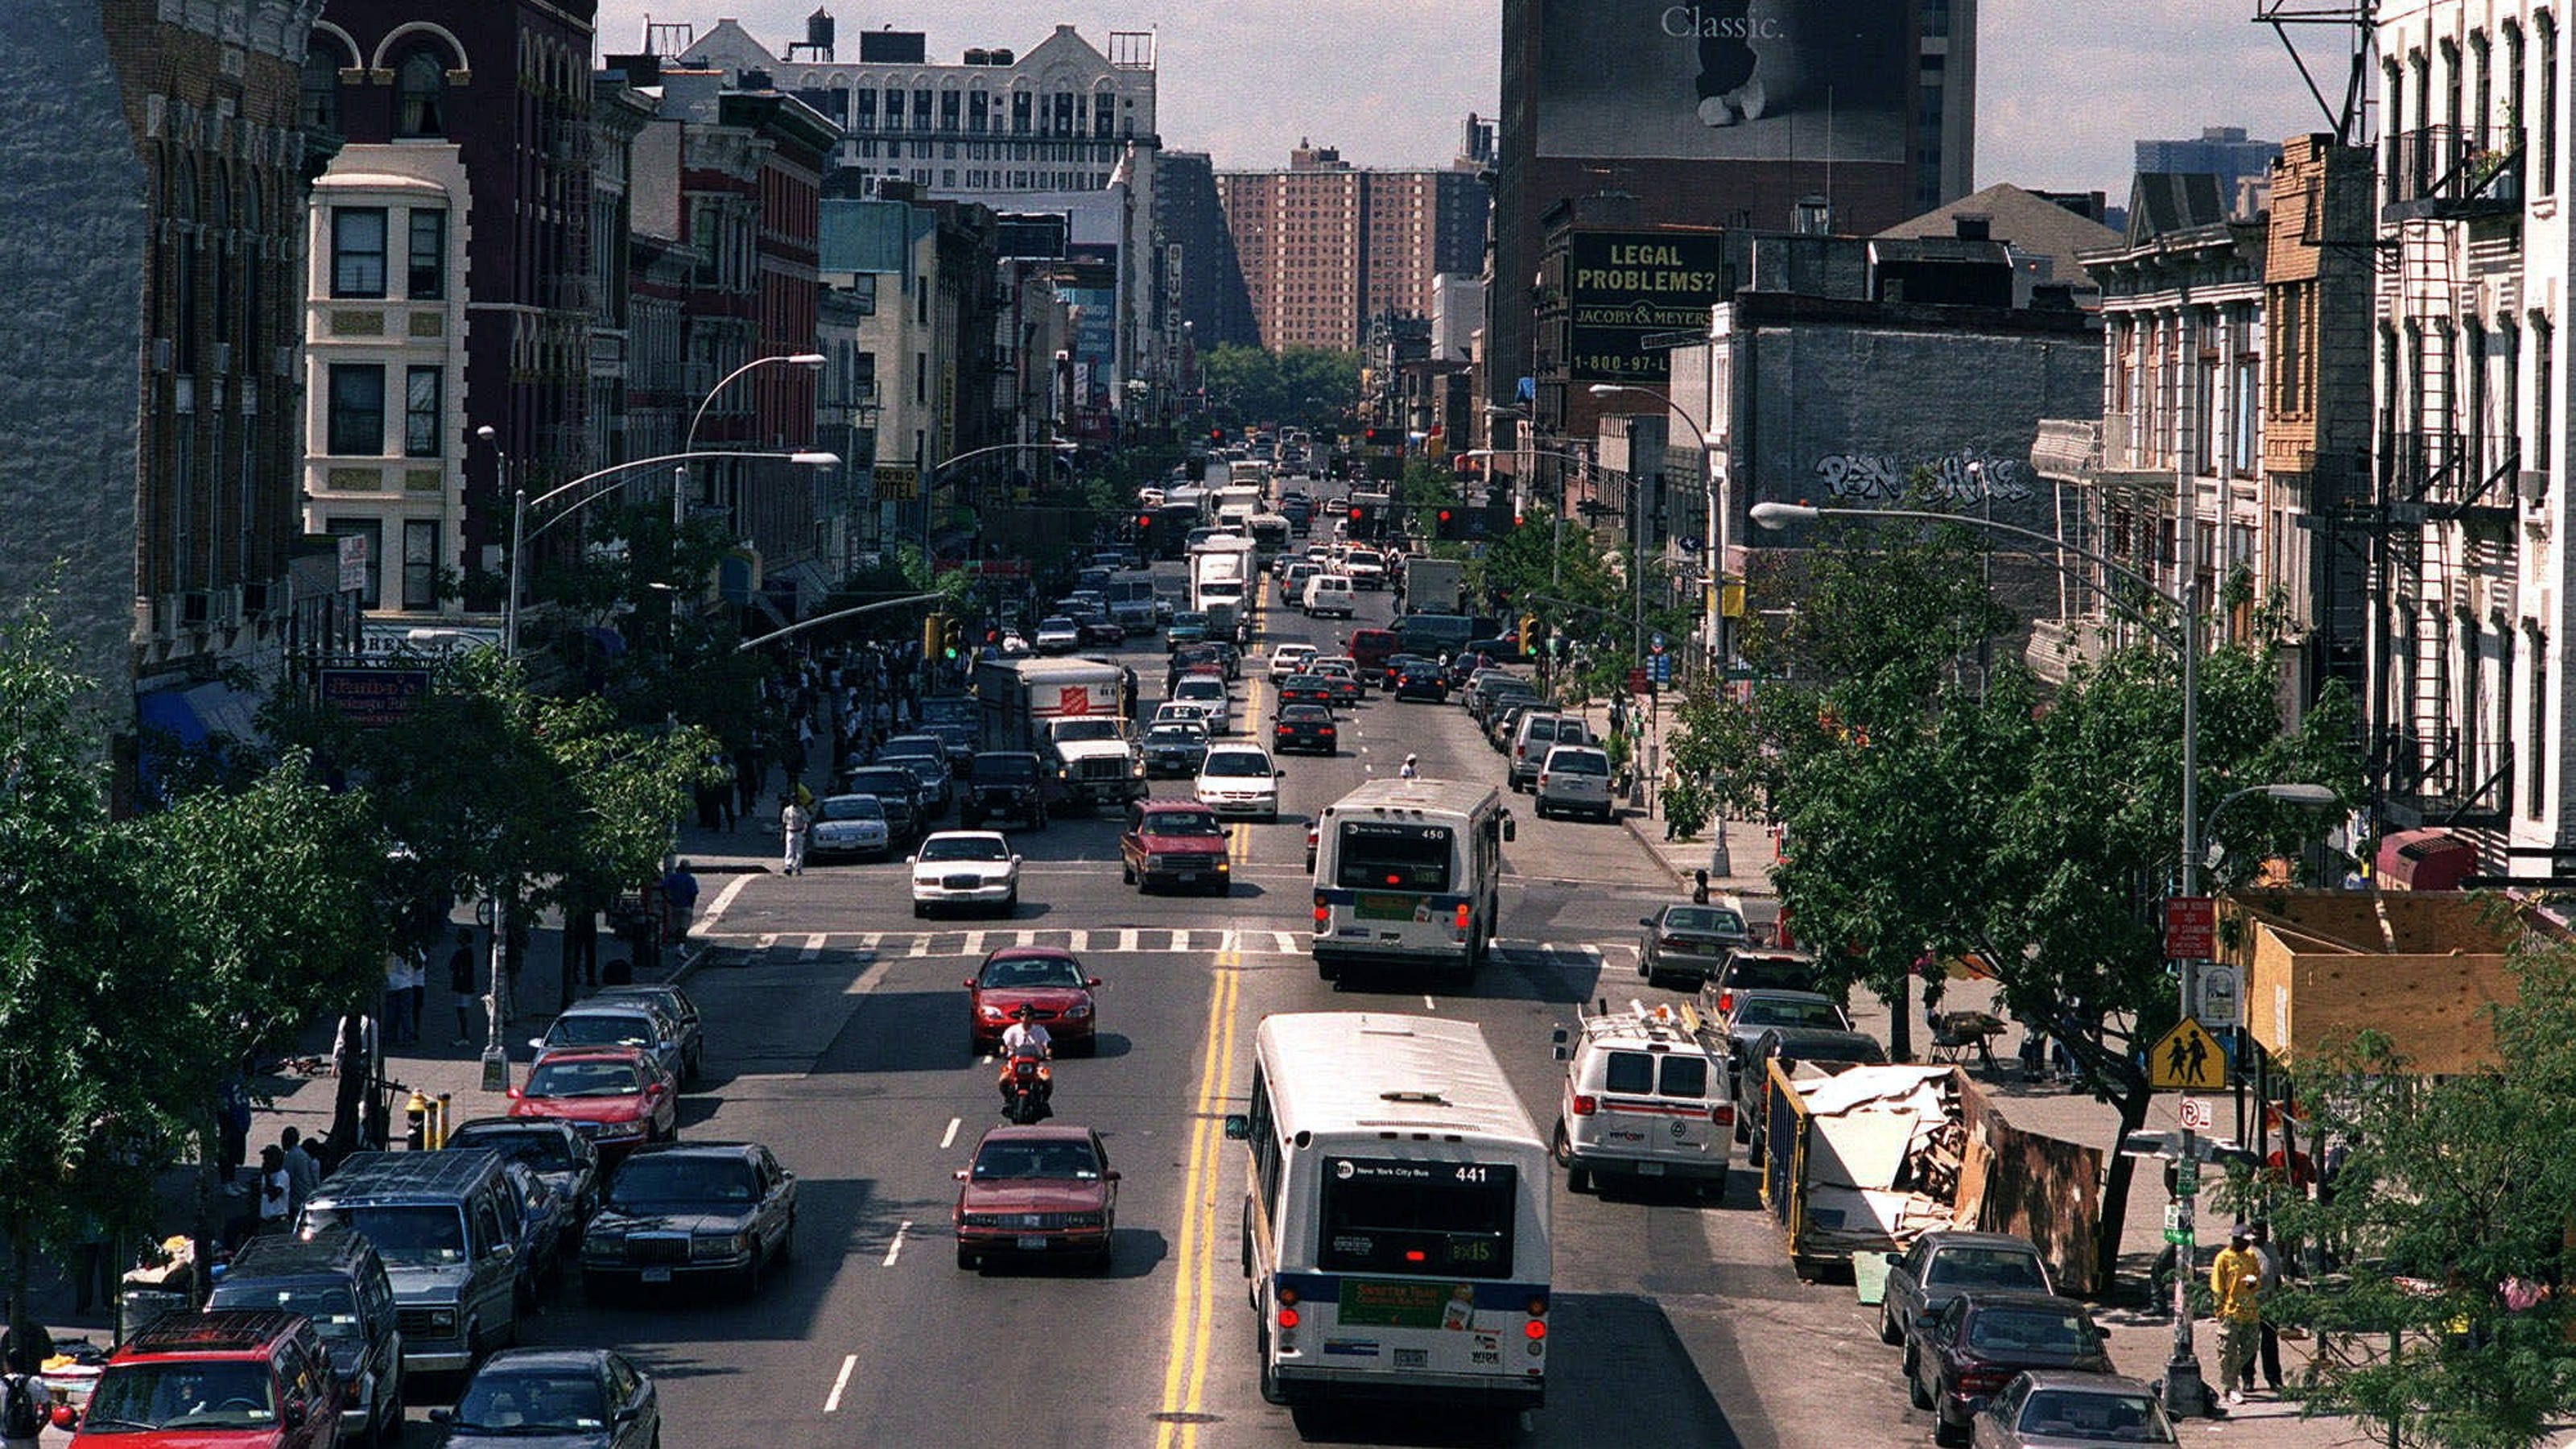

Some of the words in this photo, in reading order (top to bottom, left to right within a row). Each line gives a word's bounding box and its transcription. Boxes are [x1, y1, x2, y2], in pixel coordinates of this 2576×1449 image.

[1661, 6, 1784, 39] Classic.
[1611, 245, 1683, 266] LEGAL
[1577, 269, 1715, 291] PROBLEMS?
[1577, 310, 1633, 323] JACOBY
[1634, 306, 1650, 324] &
[1654, 312, 1712, 325] MEYERS
[1422, 829, 1444, 840] 450
[1376, 1167, 1393, 1175] York
[1396, 1167, 1412, 1178] City
[1414, 1169, 1430, 1177] Bus
[1455, 1167, 1487, 1183] 441
[1472, 1351, 1499, 1363] WIDE
